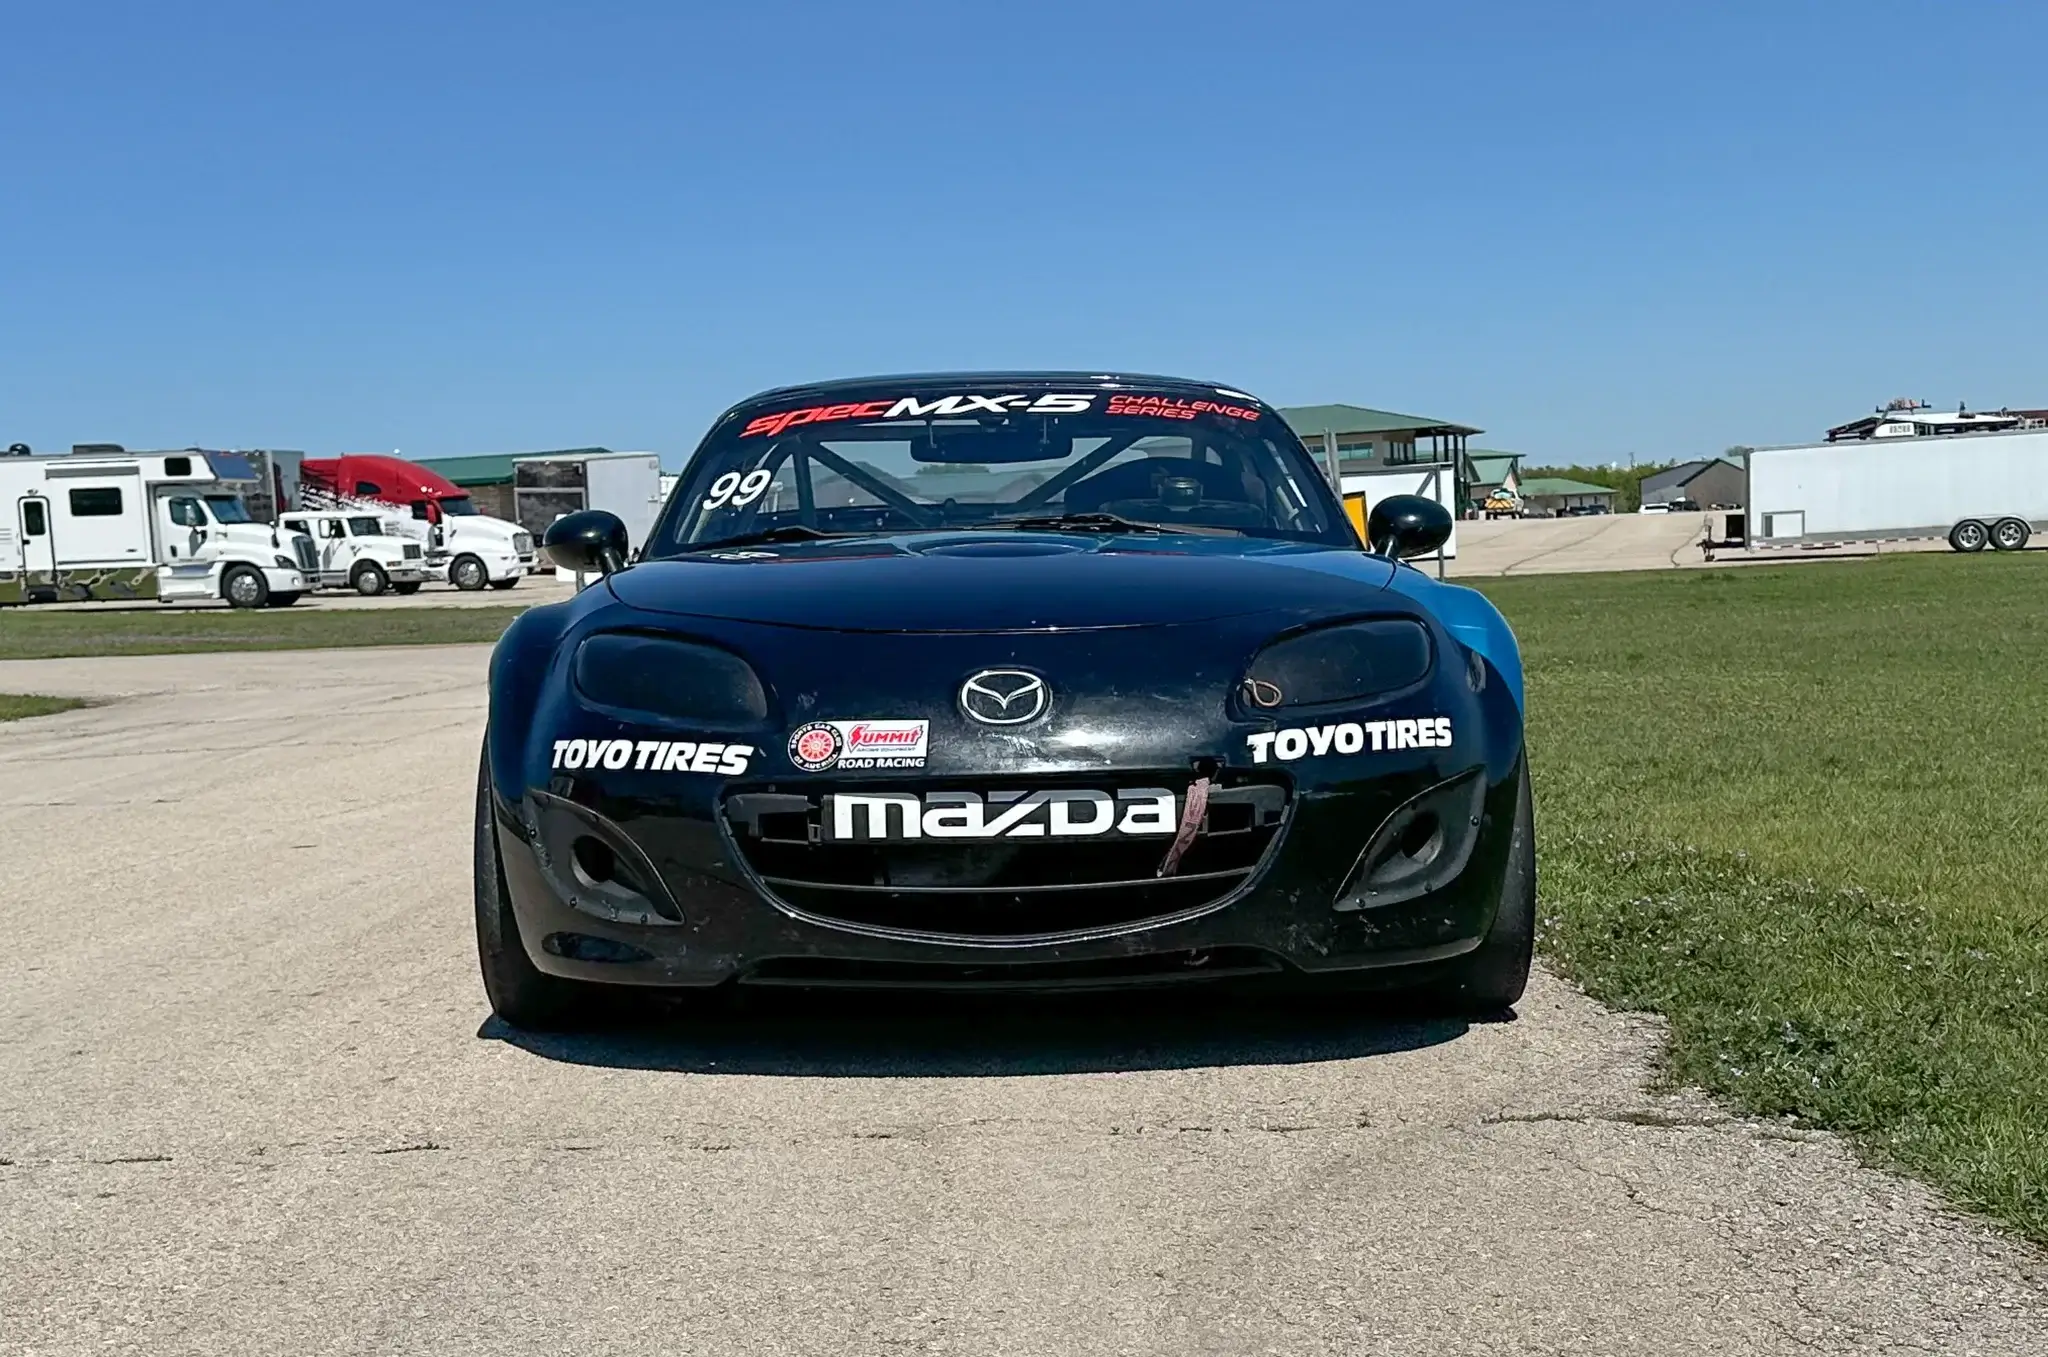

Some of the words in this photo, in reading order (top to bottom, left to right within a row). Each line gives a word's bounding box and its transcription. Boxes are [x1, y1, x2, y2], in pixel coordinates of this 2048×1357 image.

[1105, 405, 1196, 420] SERIES
[1109, 395, 1261, 421] CHALLENGE
[702, 469, 771, 510] 99
[1246, 722, 1364, 764] TOYO
[1364, 717, 1452, 751] TIRES
[552, 739, 634, 770] TOYO
[634, 740, 754, 776] TIRES
[838, 759, 876, 769] ROAD
[876, 758, 925, 768] RACING
